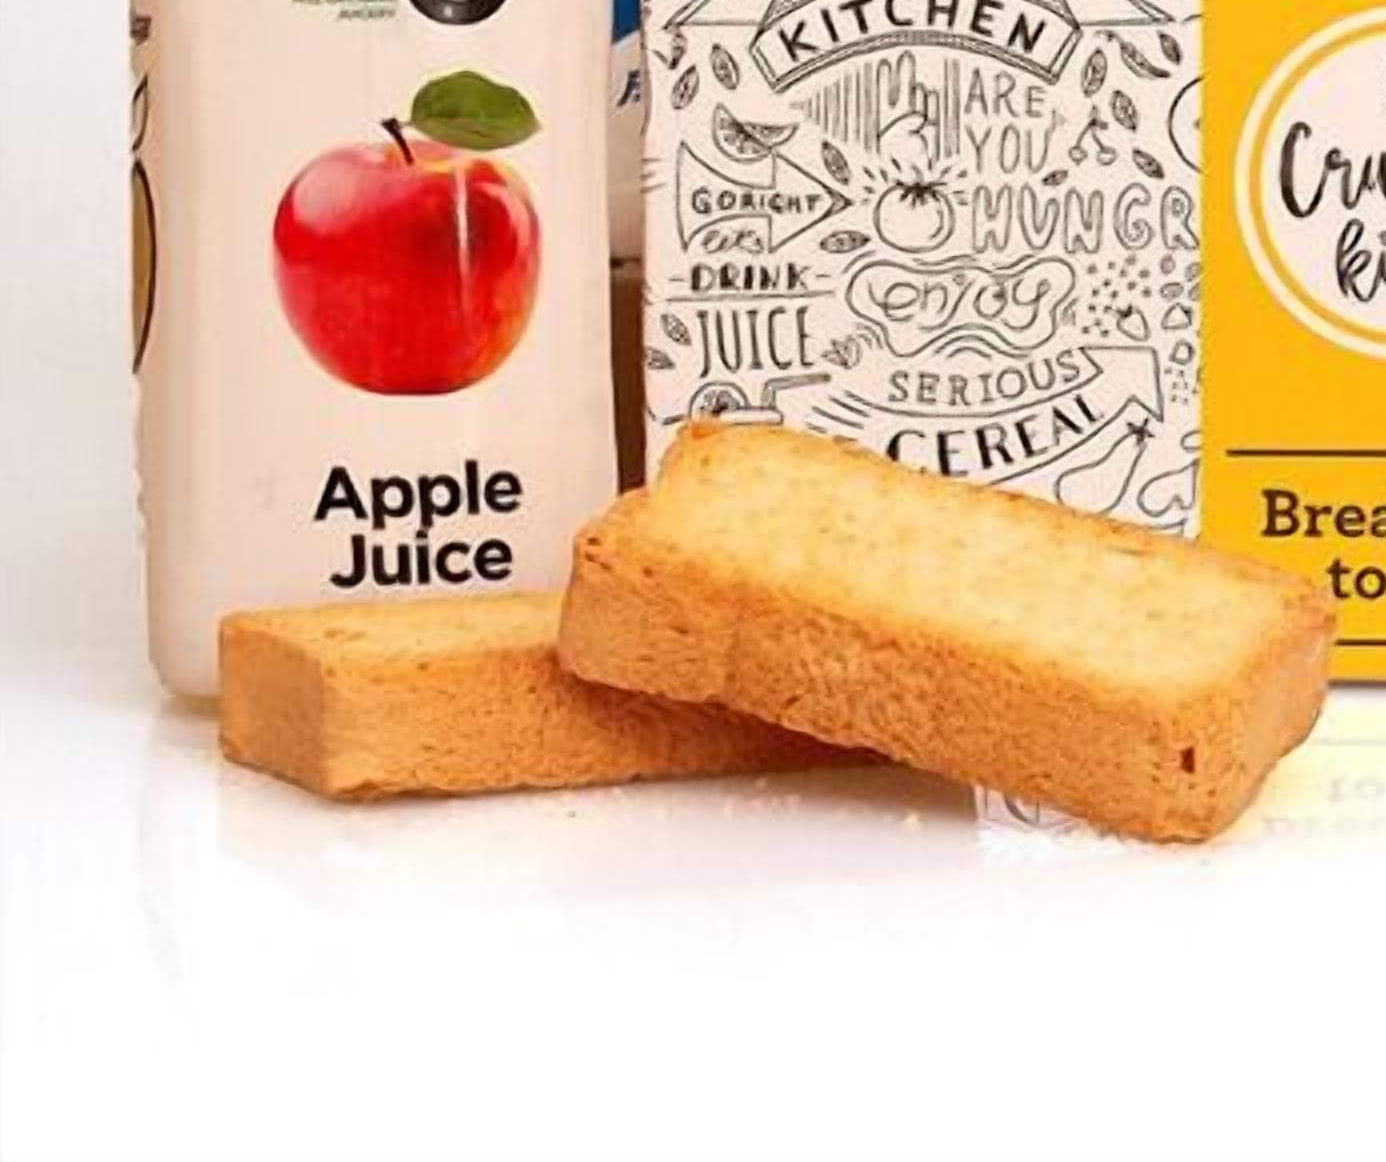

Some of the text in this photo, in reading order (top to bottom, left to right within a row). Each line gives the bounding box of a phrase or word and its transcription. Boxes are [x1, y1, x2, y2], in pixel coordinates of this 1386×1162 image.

[964, 67, 1047, 119] ARE
[966, 118, 1057, 174] YOU
[691, 262, 811, 292] DRINK
[867, 273, 1050, 330] enjoy
[696, 304, 814, 379] JUICE
[888, 349, 1081, 406] SERIOUS
[886, 393, 1103, 478] CEREAL
[313, 458, 523, 531] Apple
[329, 526, 513, 589] Juice
